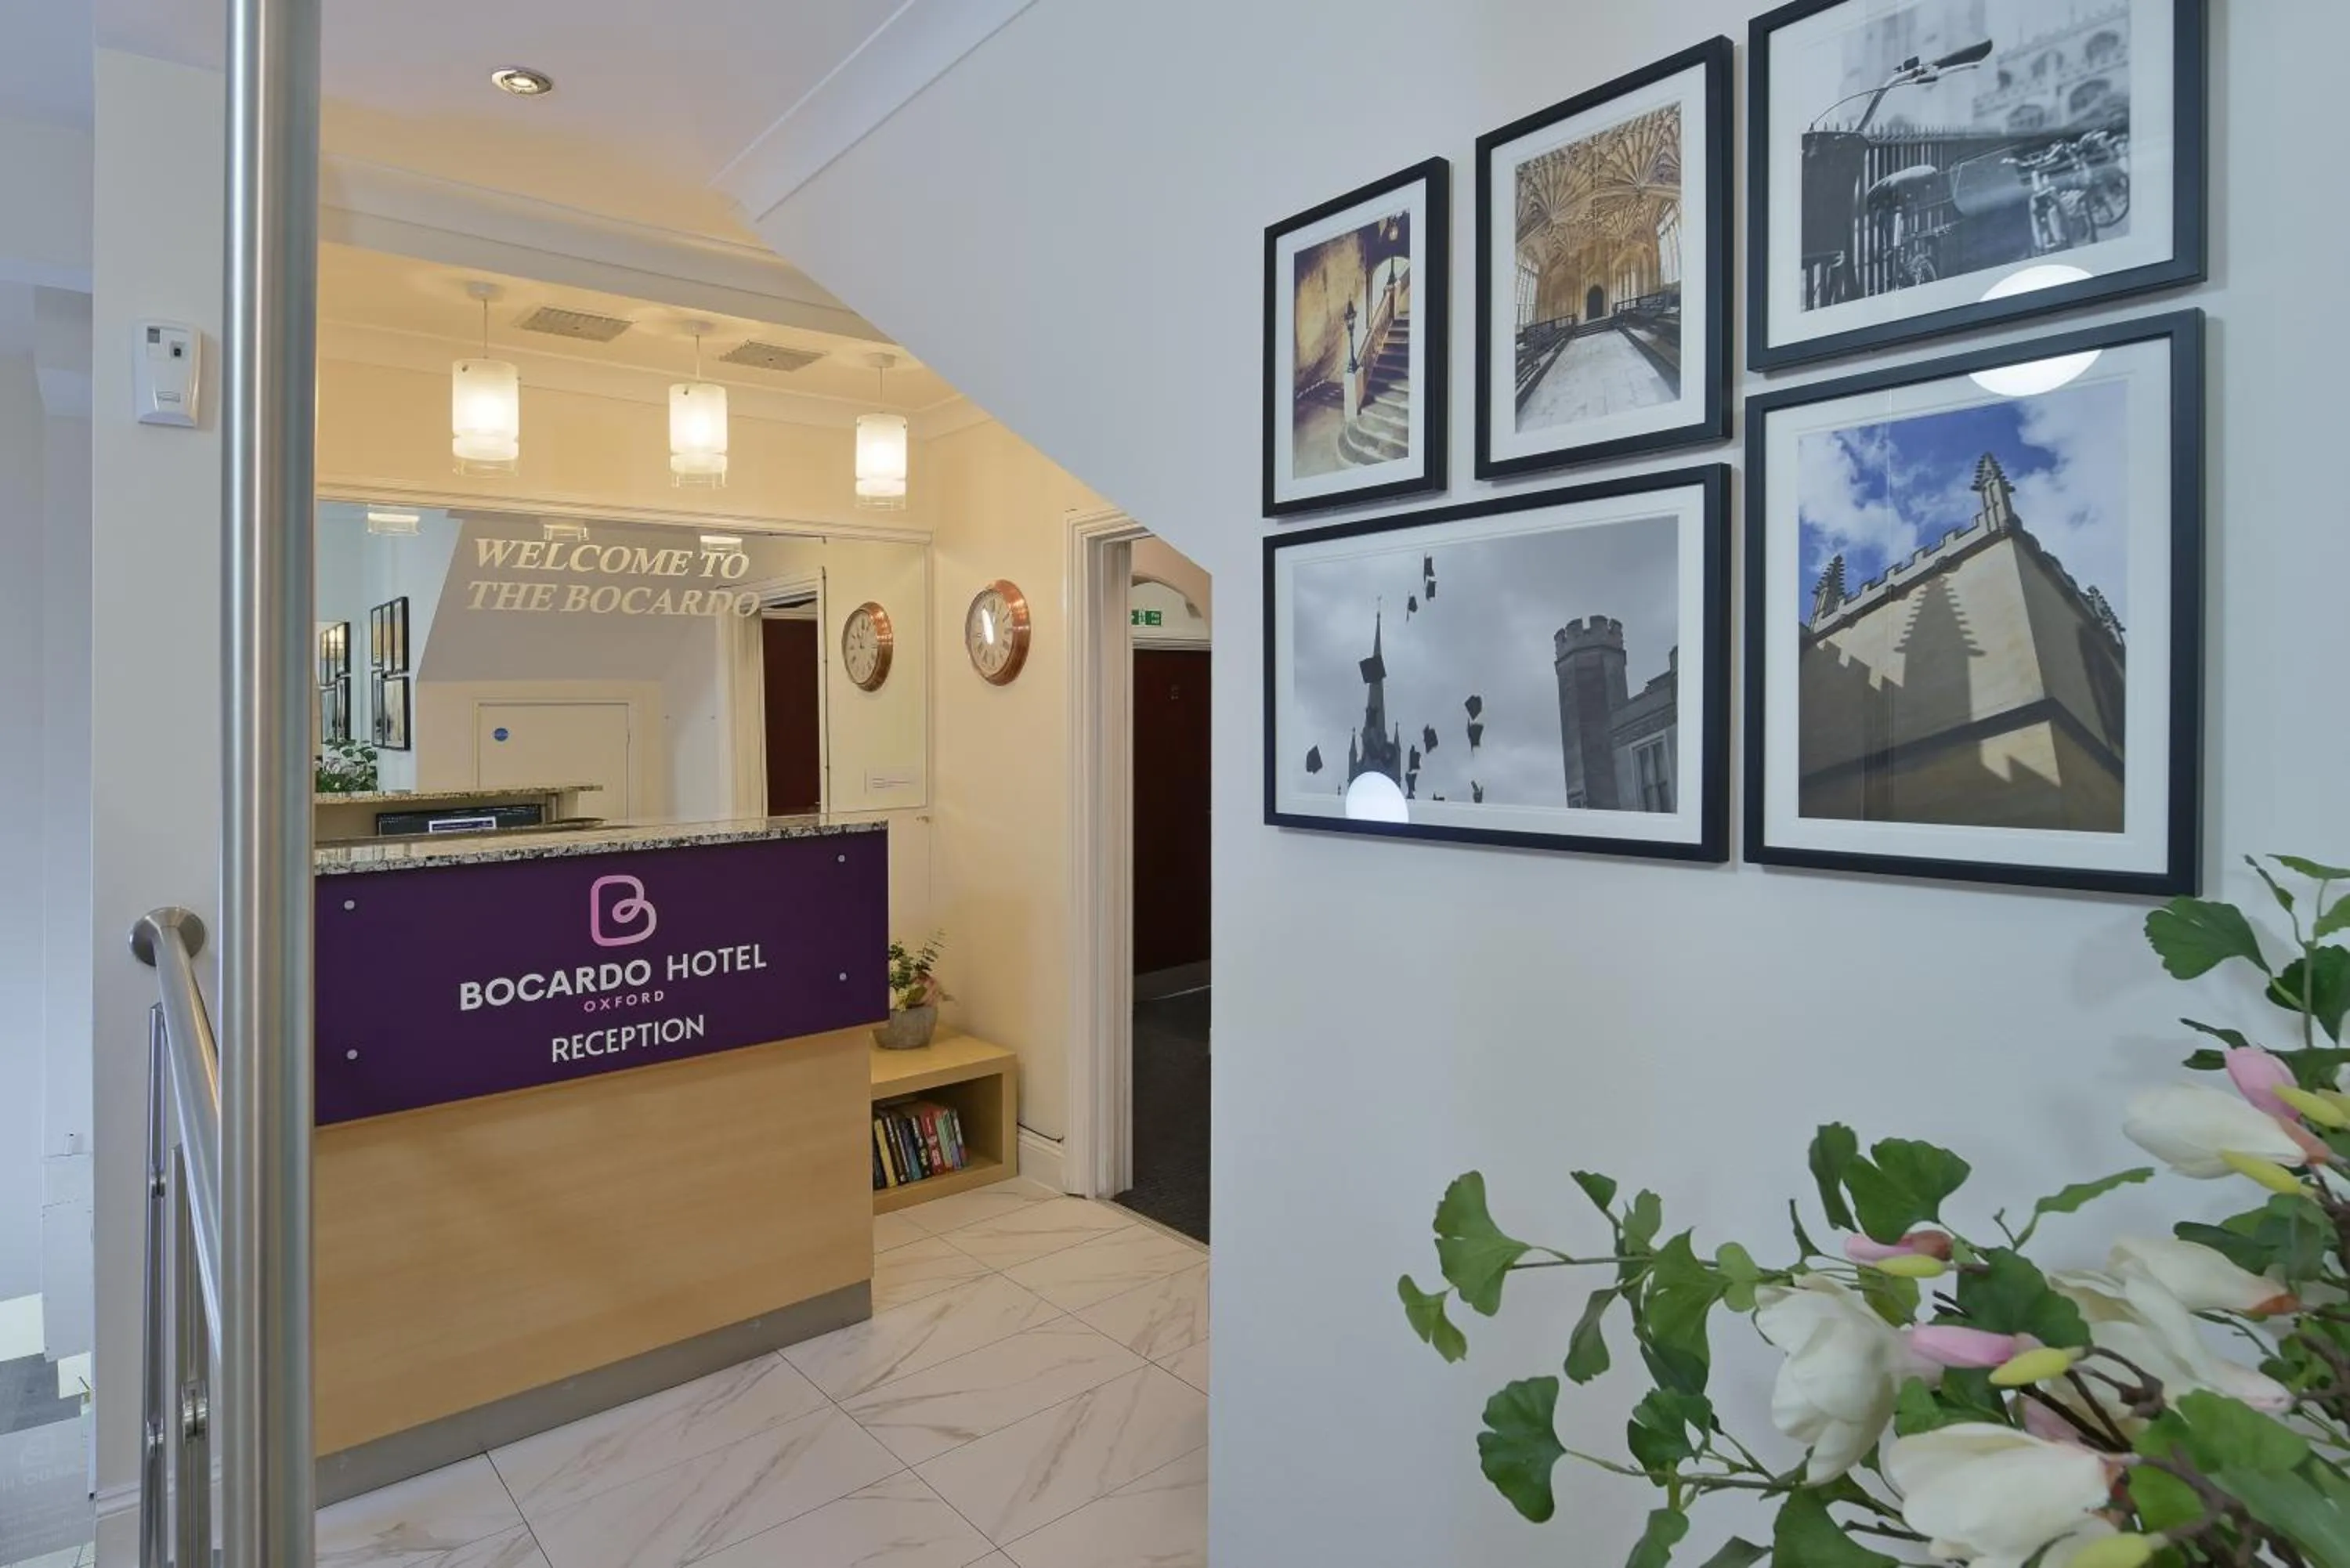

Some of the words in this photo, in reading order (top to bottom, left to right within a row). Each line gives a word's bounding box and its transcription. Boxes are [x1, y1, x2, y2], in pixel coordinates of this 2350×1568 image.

[475, 538, 693, 576] WELCOME
[700, 551, 750, 579] TO
[467, 580, 557, 611] THE
[560, 584, 761, 618] BOCARDO
[460, 959, 652, 1010] BOCARDO
[667, 944, 767, 981] HOTEL
[584, 990, 664, 1013] OXFORD
[551, 1014, 705, 1064] RECEPTION
